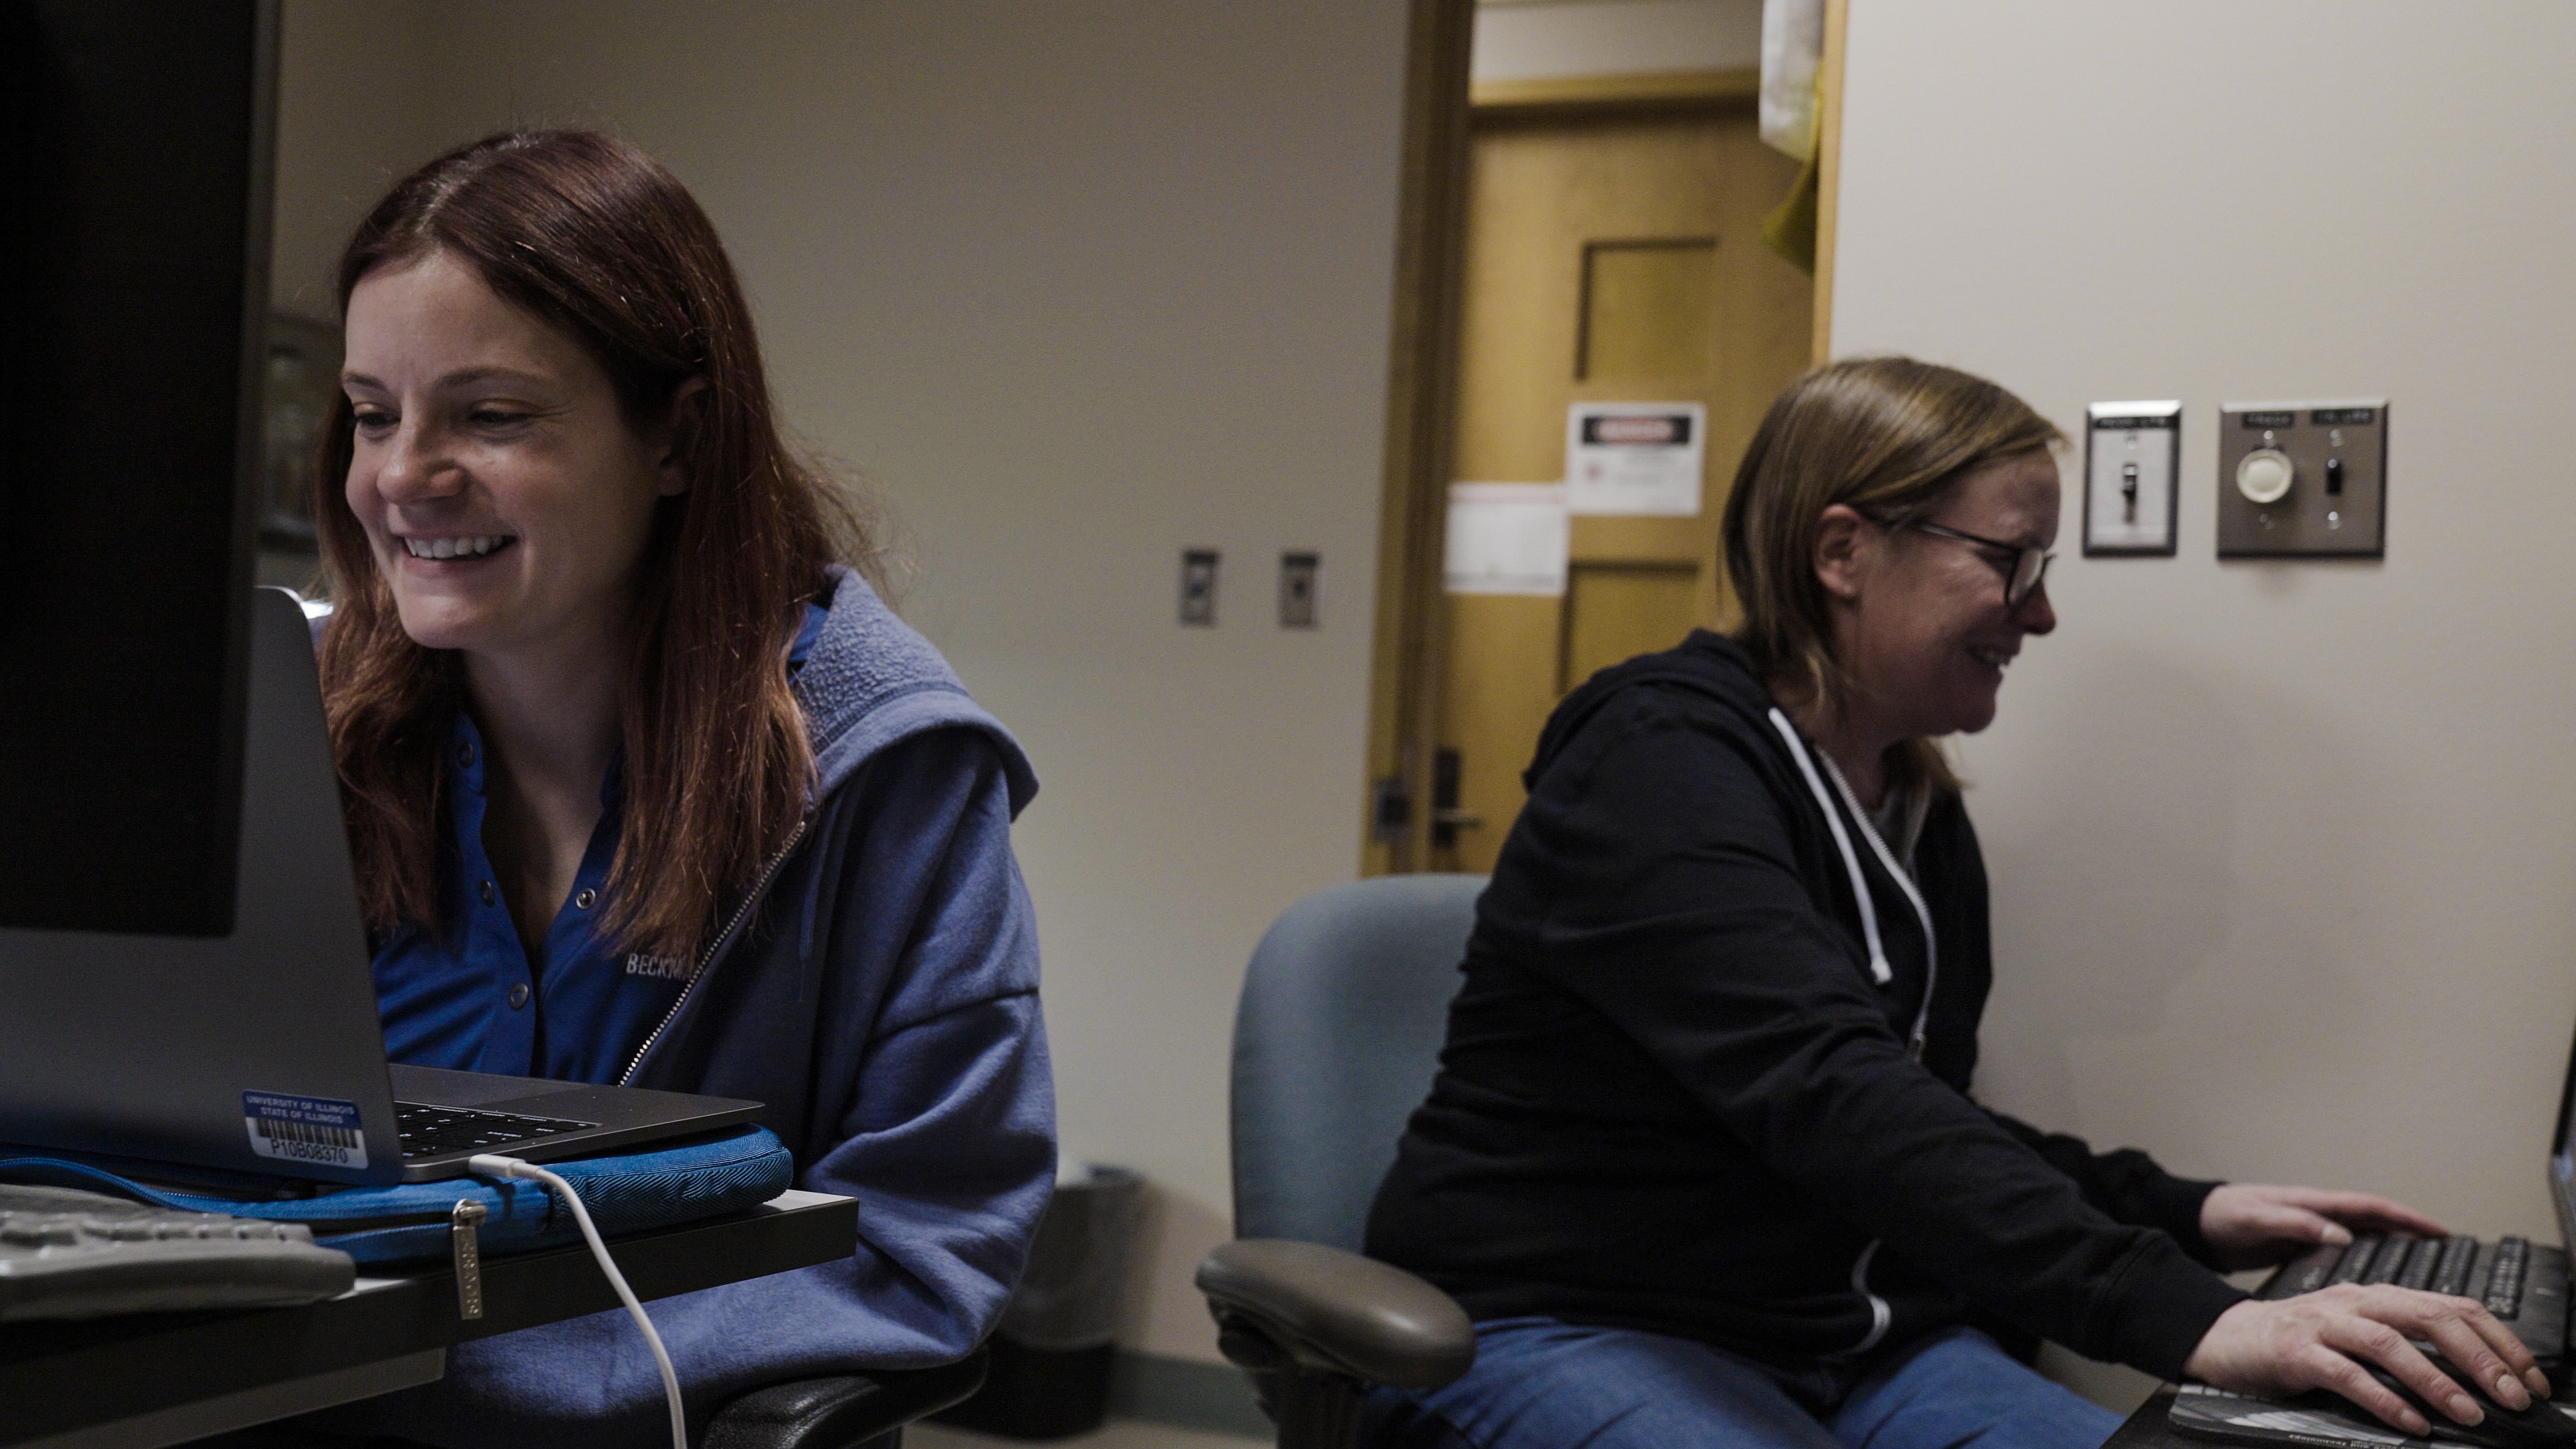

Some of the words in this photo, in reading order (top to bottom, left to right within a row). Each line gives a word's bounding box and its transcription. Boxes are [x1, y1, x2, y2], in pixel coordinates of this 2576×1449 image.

[246, 1095, 299, 1108] UNIVERSITY
[301, 1102, 313, 1110] OF
[315, 1104, 355, 1115] ILLINOIS
[260, 1107, 288, 1118] STATE
[290, 1110, 302, 1118] OF
[305, 1112, 343, 1124] ILLINOIS
